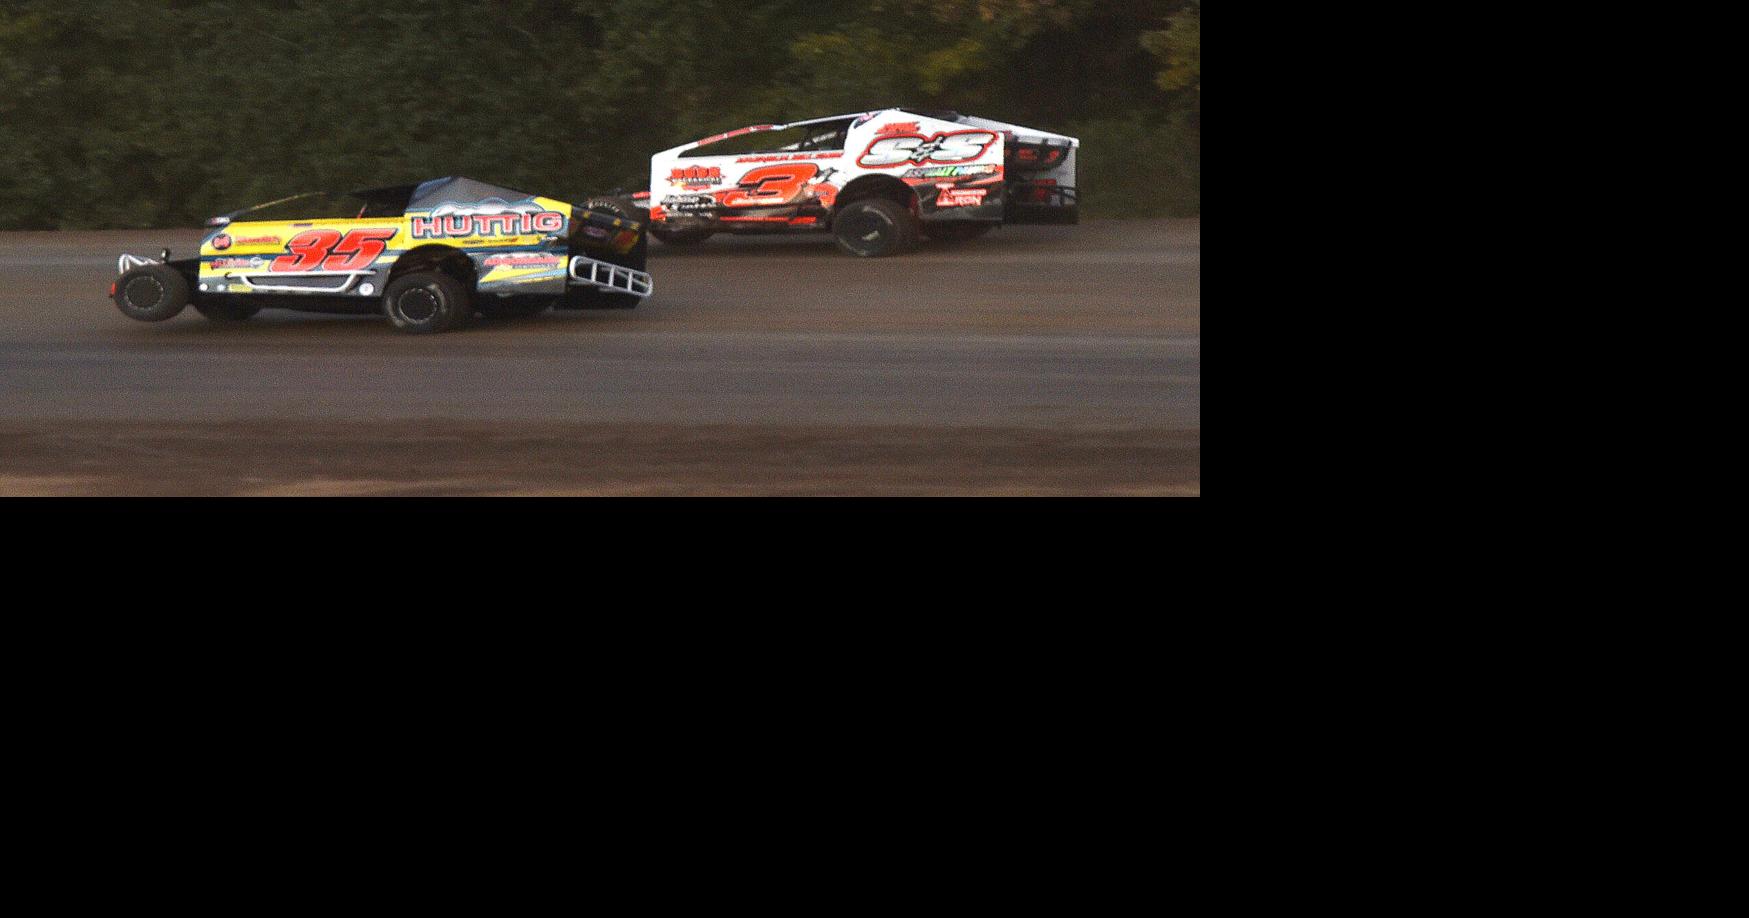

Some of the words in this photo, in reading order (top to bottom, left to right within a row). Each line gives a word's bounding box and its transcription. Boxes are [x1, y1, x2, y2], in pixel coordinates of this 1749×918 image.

[857, 130, 999, 168] S&S
[412, 211, 565, 238] HUTTIG
[269, 228, 399, 272] 35
